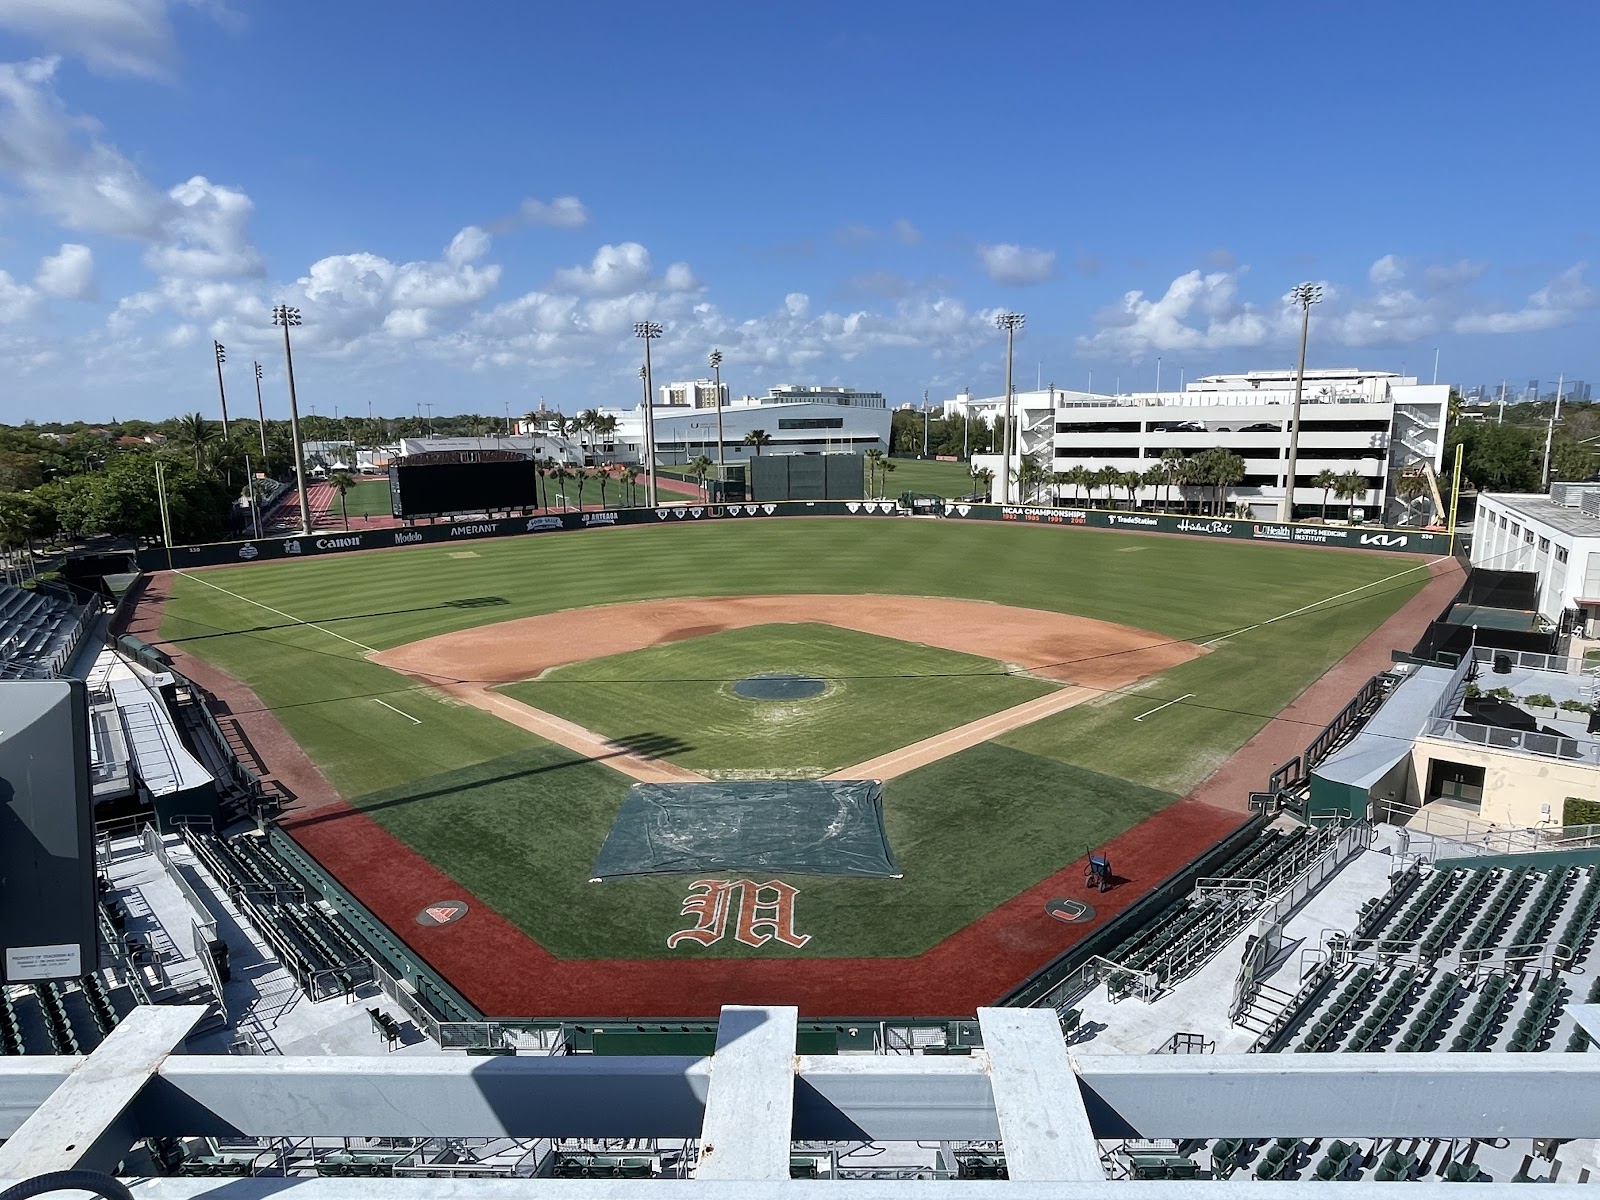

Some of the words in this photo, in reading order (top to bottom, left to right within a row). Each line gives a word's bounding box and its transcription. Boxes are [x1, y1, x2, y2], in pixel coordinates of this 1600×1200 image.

[1002, 507, 1023, 515] NCAA
[1024, 508, 1087, 519] CHAMPIONSHIPS
[1116, 515, 1158, 526] TradeStation
[450, 523, 500, 536] AMERANT
[1295, 528, 1318, 536] SPORTS
[1318, 530, 1348, 538] MEDICINE
[316, 536, 360, 550] Canon
[394, 532, 423, 544] Modelo
[1294, 534, 1327, 542] INSTITUTE
[667, 879, 812, 949] M
